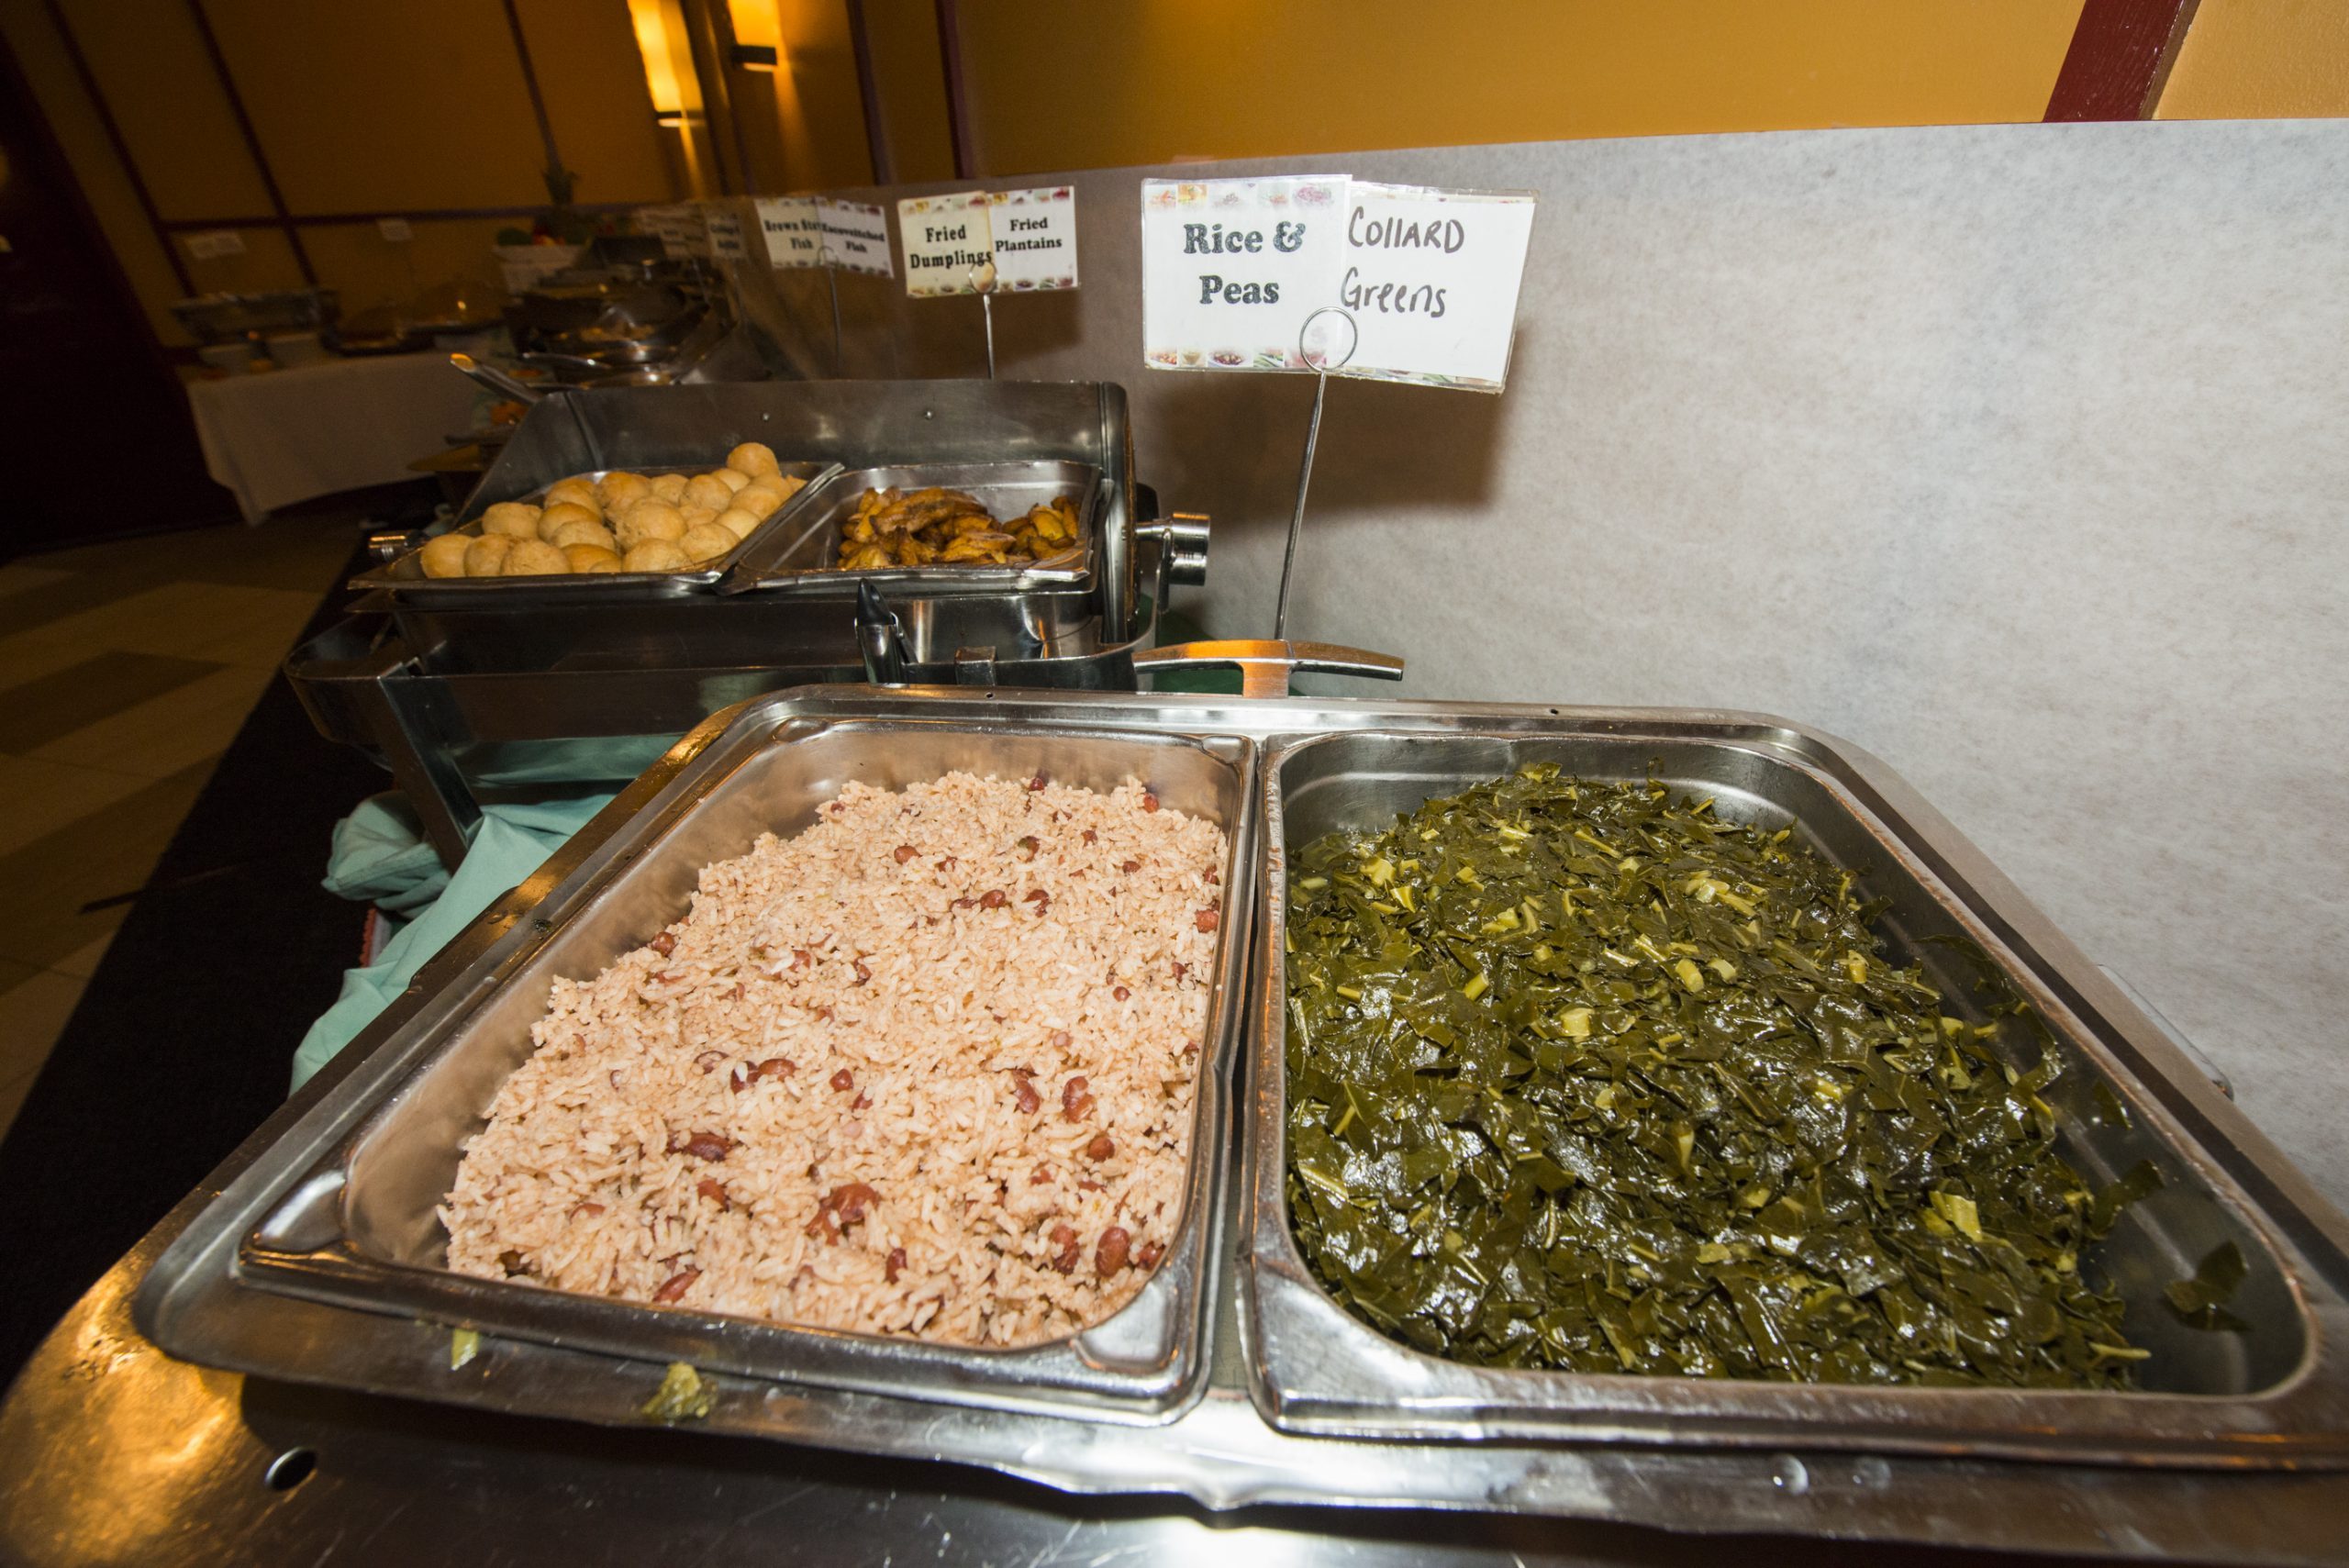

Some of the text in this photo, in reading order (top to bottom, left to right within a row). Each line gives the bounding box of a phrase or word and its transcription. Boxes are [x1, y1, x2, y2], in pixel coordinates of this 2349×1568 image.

[925, 224, 967, 242] Fried
[1010, 217, 1048, 232] Fried
[790, 237, 814, 250] Fish
[996, 238, 1063, 253] Plantains
[1183, 220, 1307, 254] Rice &
[909, 250, 993, 270] Dumplings
[1199, 274, 1280, 306] Peas
[1340, 266, 1447, 318] Greens
